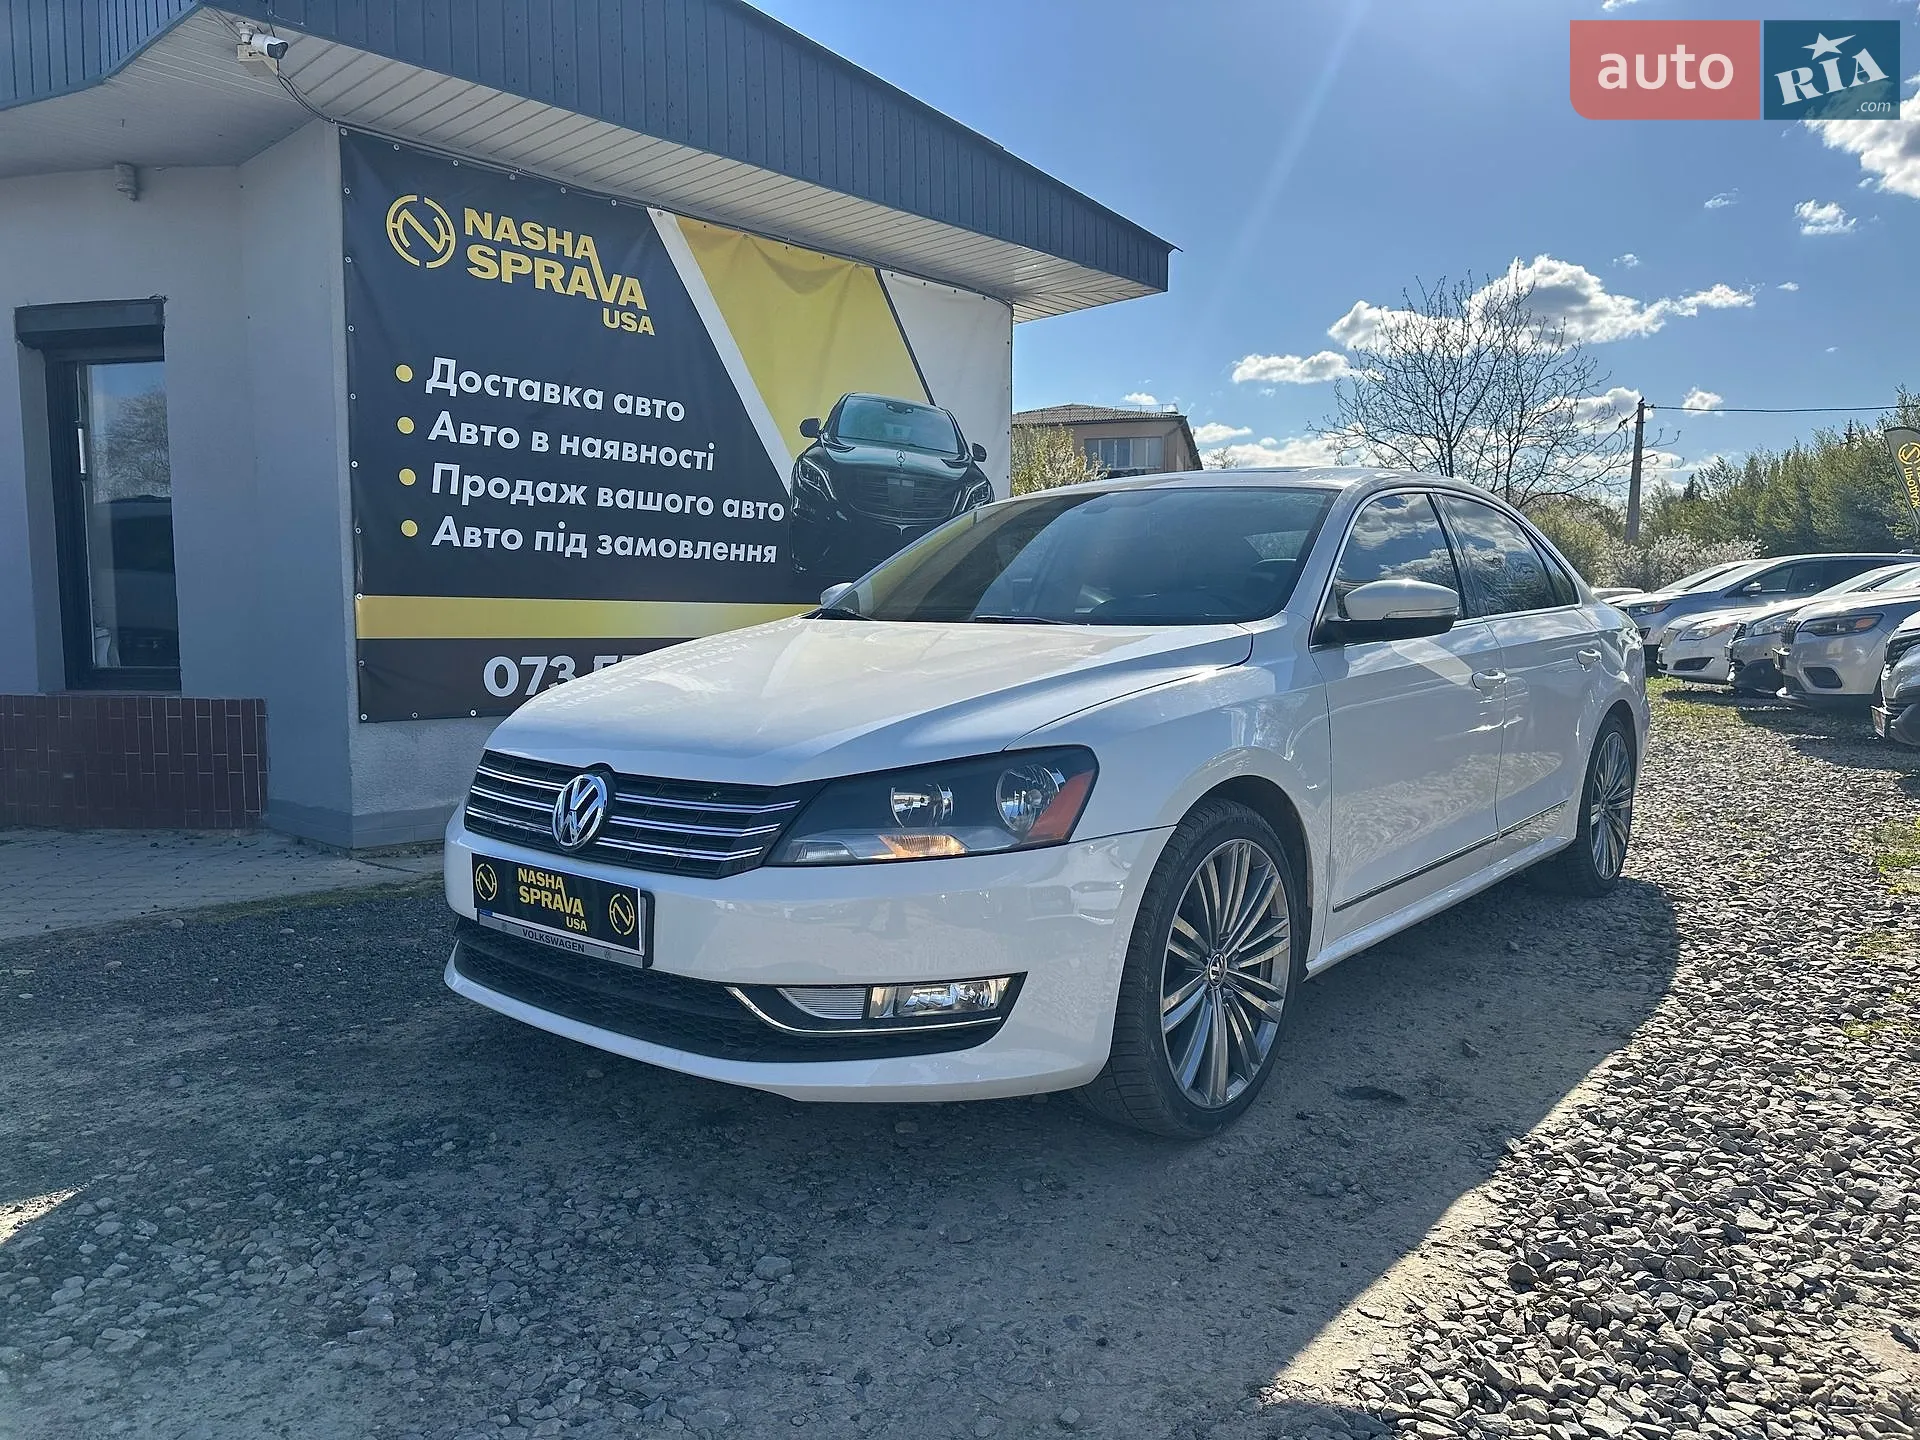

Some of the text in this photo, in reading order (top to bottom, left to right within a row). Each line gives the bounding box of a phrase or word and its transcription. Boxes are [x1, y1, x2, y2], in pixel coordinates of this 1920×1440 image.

[464, 207, 600, 260] NASHA
[466, 244, 647, 310] SPRAVA
[602, 308, 655, 336] USA
[425, 356, 686, 422] Доставка авто
[427, 410, 715, 471] Авто в наявності
[431, 462, 786, 522] Продаж вашого авто
[430, 516, 778, 563] Авто під замовлення
[483, 655, 577, 698] 073
[517, 868, 564, 890] NASHA
[519, 885, 585, 918] SPRAVA
[522, 928, 585, 953] VOLKSWAGEN
[566, 917, 588, 932] USA
